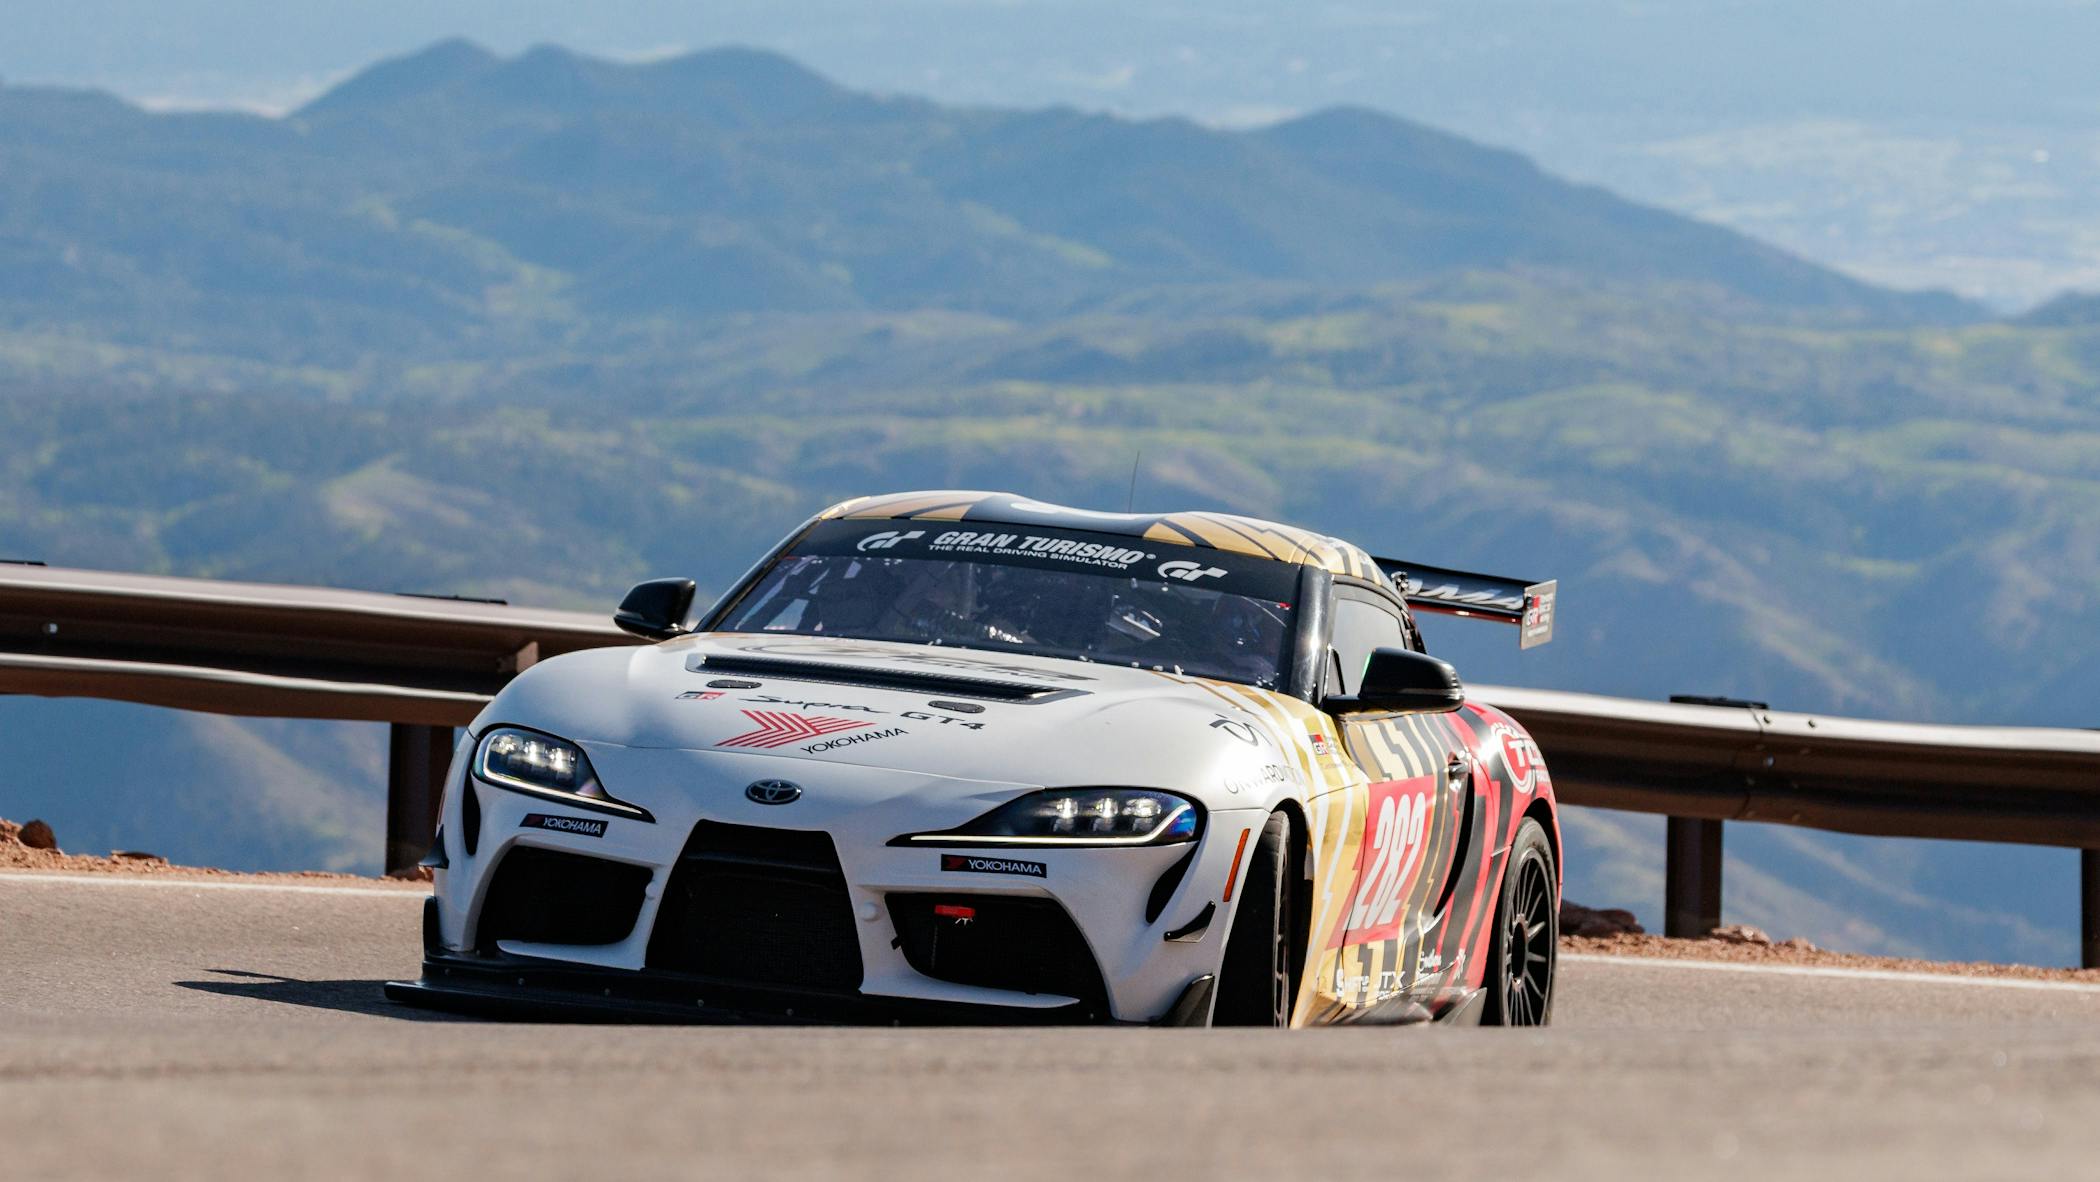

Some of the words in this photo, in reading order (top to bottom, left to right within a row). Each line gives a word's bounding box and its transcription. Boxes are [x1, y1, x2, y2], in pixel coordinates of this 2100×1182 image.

[933, 531, 1018, 548] GRAN
[993, 547, 1047, 559] DRIVING
[1050, 553, 1128, 570] SIMULATOR
[737, 695, 891, 714] Supra
[900, 711, 986, 730] GT4
[801, 727, 910, 754] YOKOHAMA
[543, 817, 601, 834] YOKOHAMA
[968, 858, 1042, 875] YOKOHAMA
[1342, 791, 1426, 931] 282
